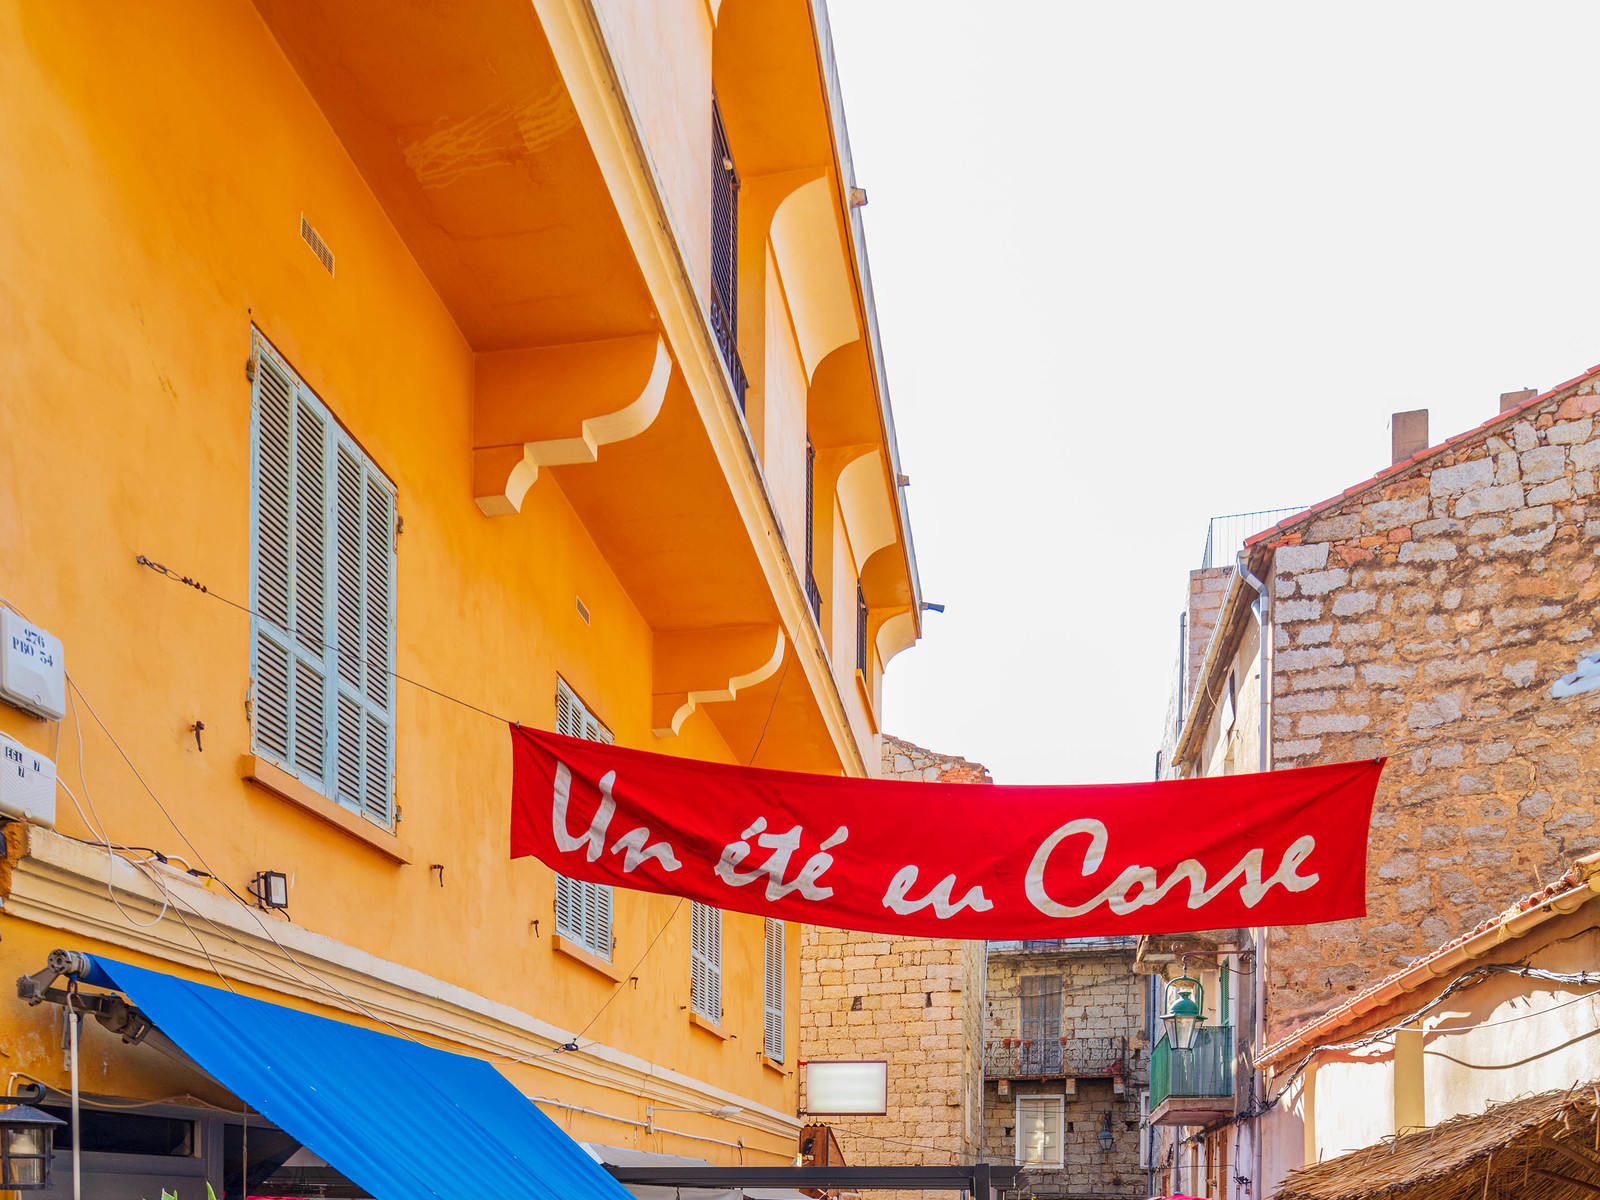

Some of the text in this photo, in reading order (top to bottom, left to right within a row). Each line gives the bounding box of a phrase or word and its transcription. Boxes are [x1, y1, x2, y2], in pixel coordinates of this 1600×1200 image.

[552, 760, 1320, 920] Un été en Corse
